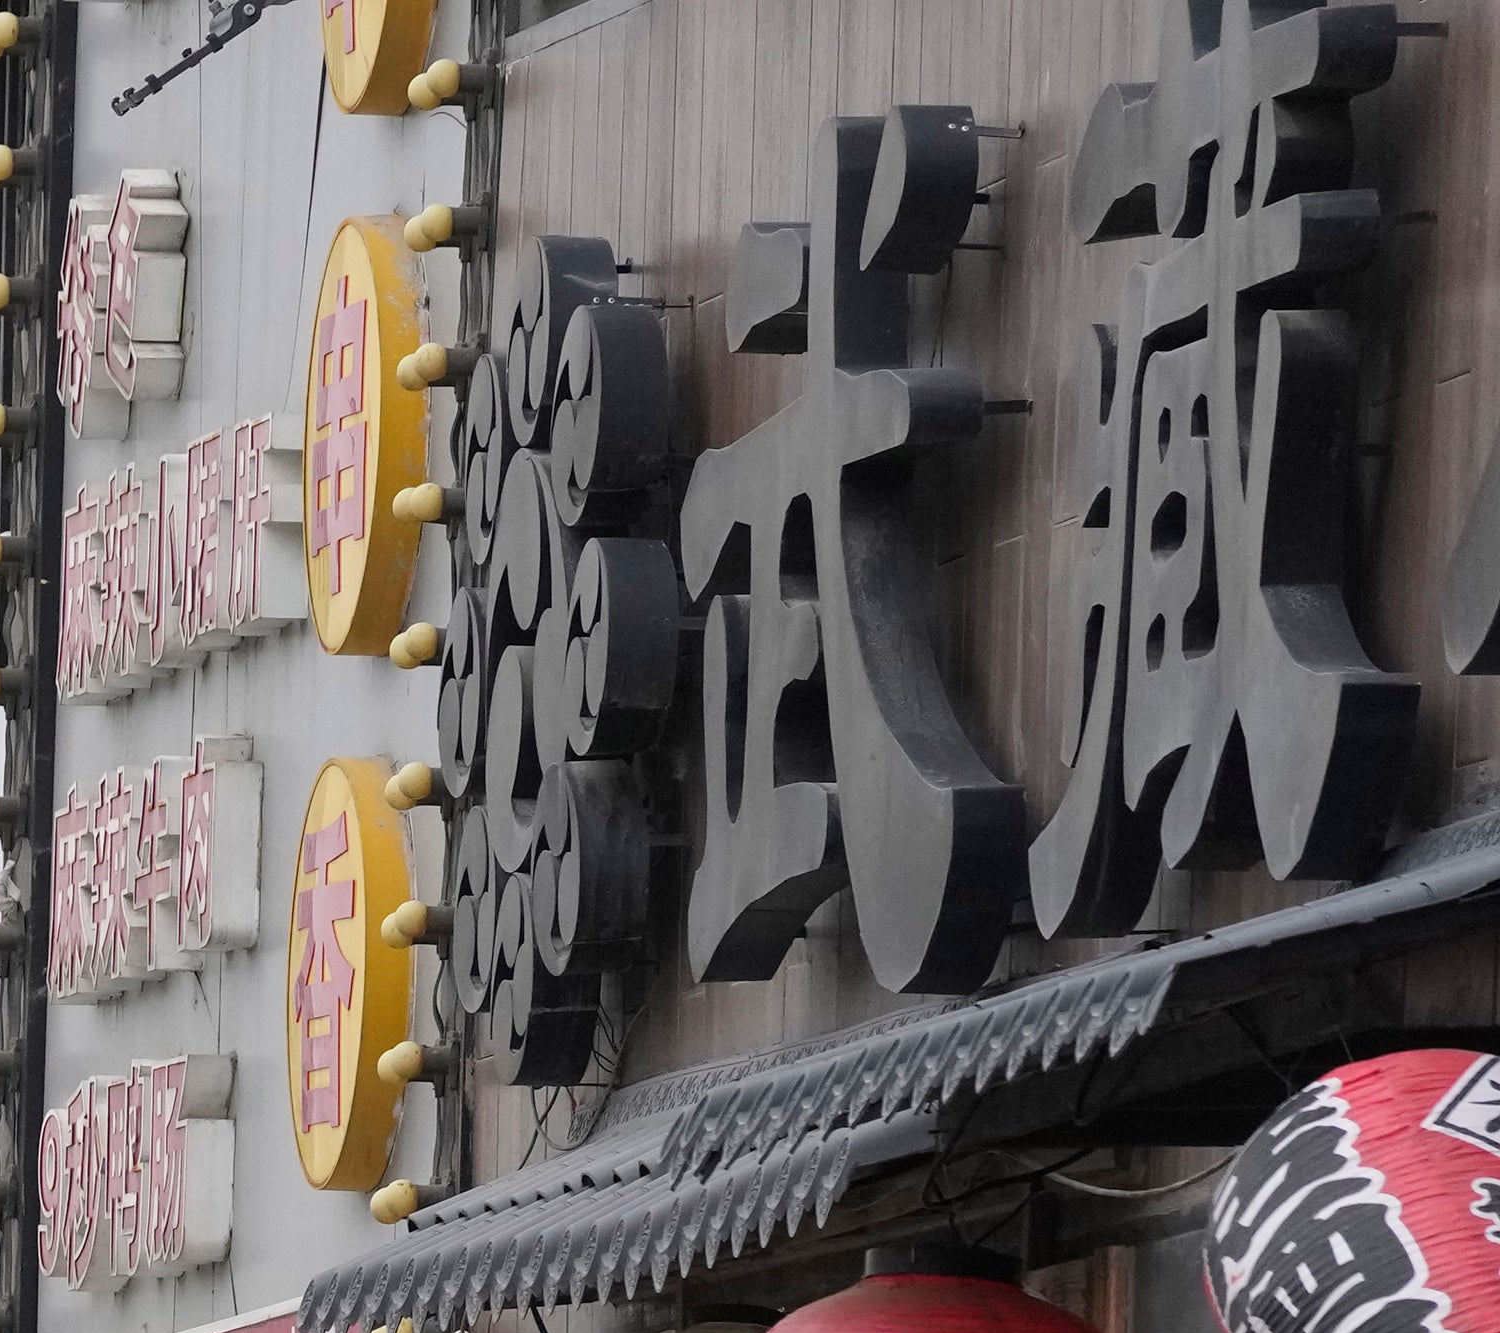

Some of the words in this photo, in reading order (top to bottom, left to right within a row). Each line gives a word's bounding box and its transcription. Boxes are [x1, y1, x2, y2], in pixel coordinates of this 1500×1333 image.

[57, 168, 145, 440] 特色
[680, 0, 1500, 994] 武藏
[48, 738, 217, 1000] 麻辣牛肉
[39, 1058, 188, 1293] 9秒鸭肠
